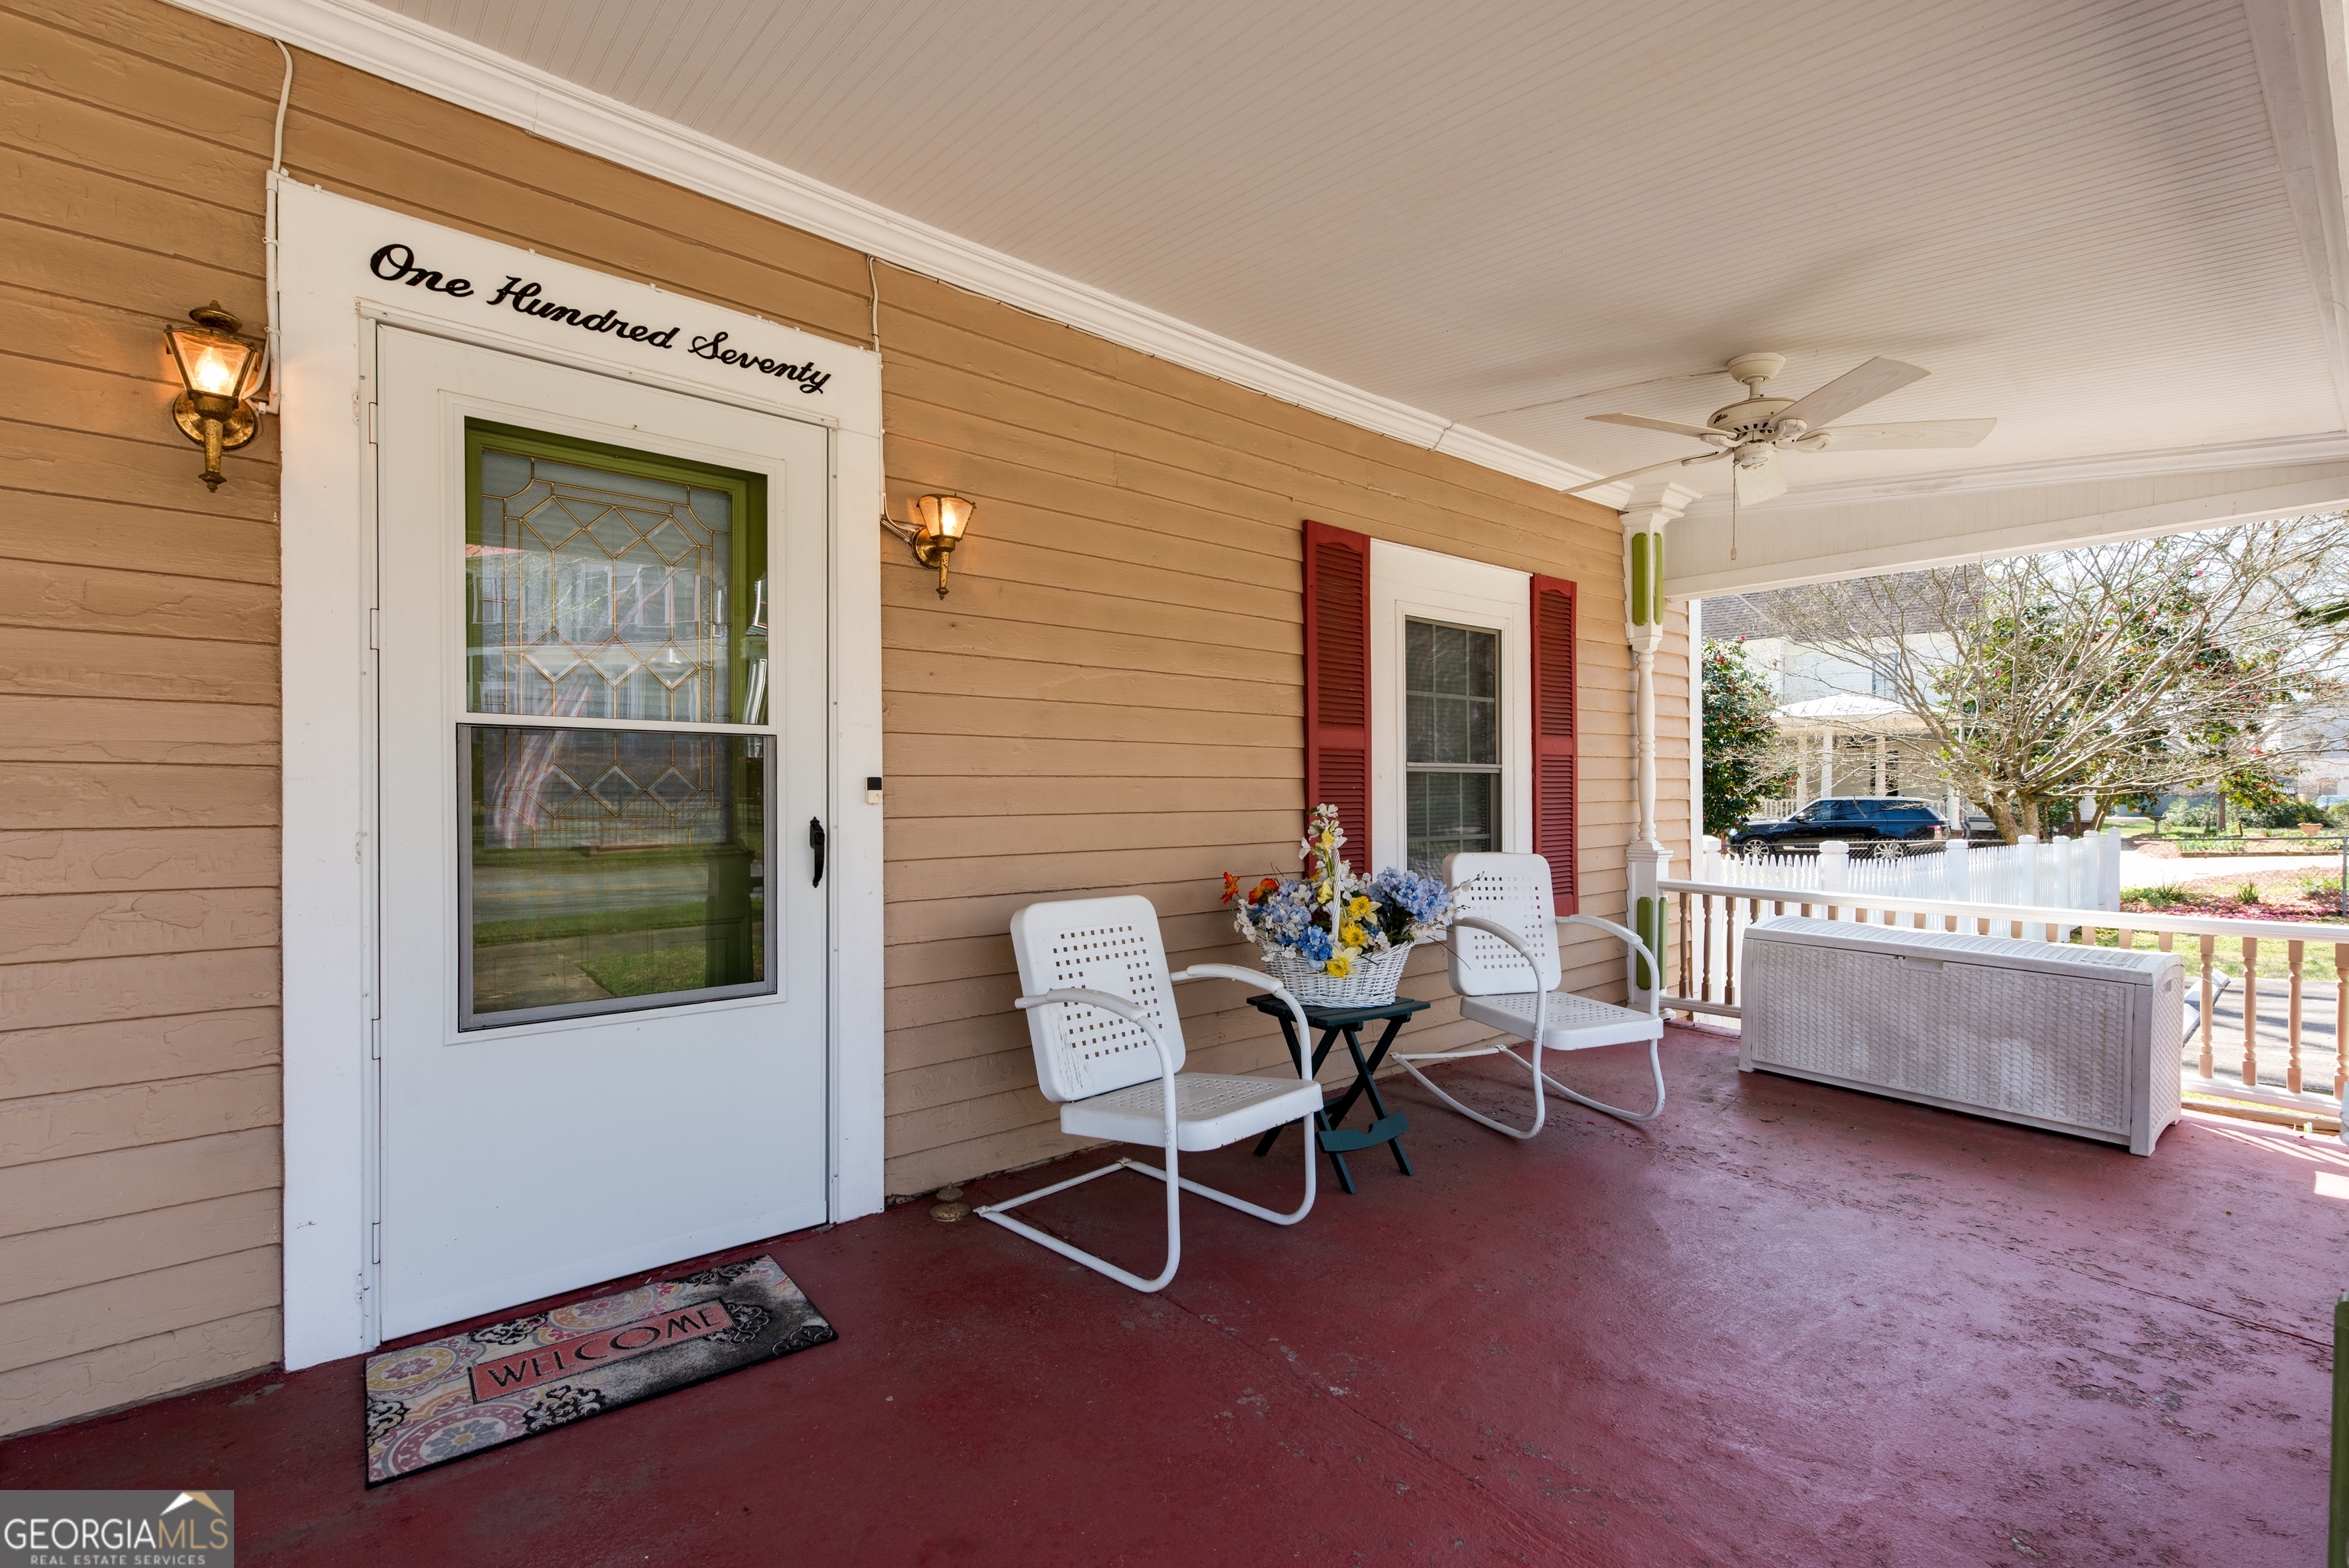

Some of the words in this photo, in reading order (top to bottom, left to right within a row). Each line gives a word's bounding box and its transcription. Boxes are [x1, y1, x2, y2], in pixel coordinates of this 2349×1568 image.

[369, 243, 475, 298] One
[486, 275, 681, 349] Hundred
[687, 331, 833, 395] Seventy
[487, 1305, 722, 1388] WELCOME
